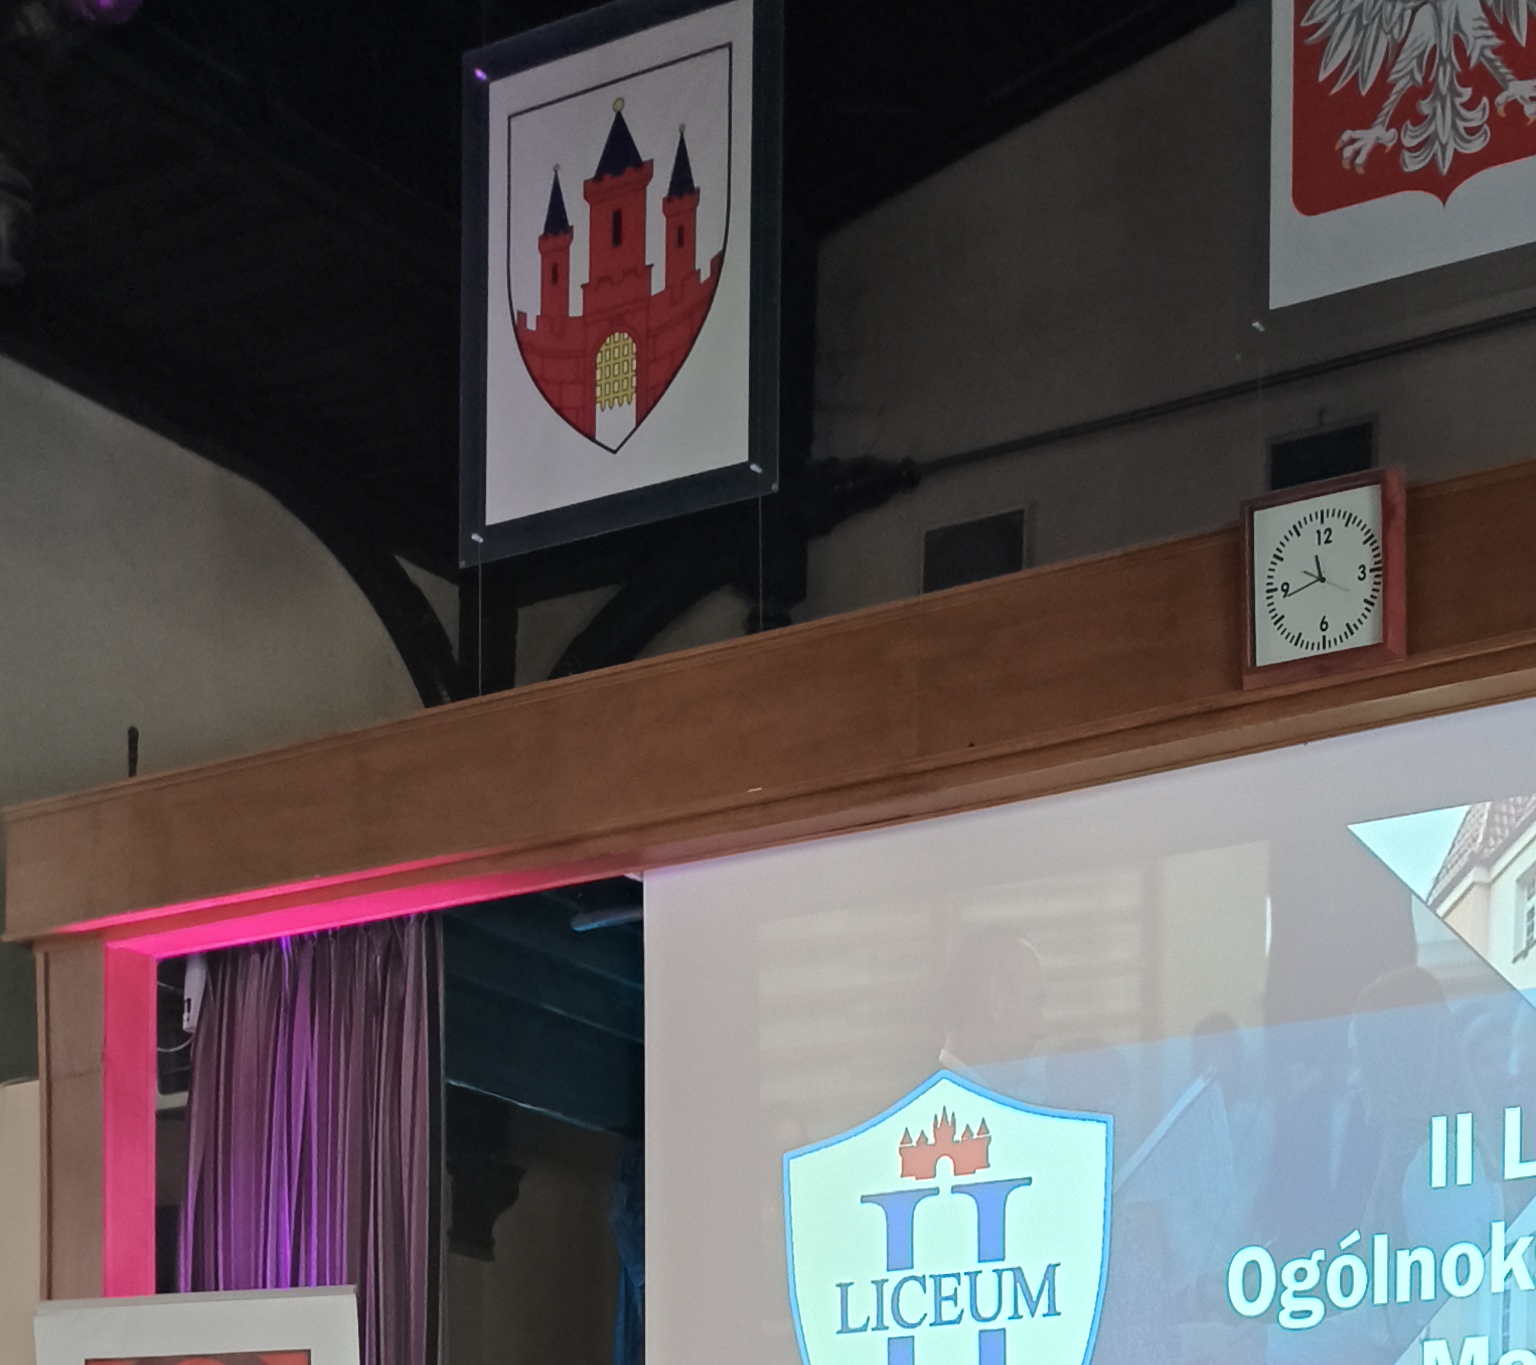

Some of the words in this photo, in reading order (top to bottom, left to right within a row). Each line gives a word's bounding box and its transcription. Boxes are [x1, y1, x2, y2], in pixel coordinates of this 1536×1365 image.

[1316, 527, 1333, 546] 12
[1357, 564, 1367, 581] 3
[1281, 582, 1290, 598] 9
[1319, 615, 1329, 632] 6
[836, 1262, 1061, 1334] LICEUM
